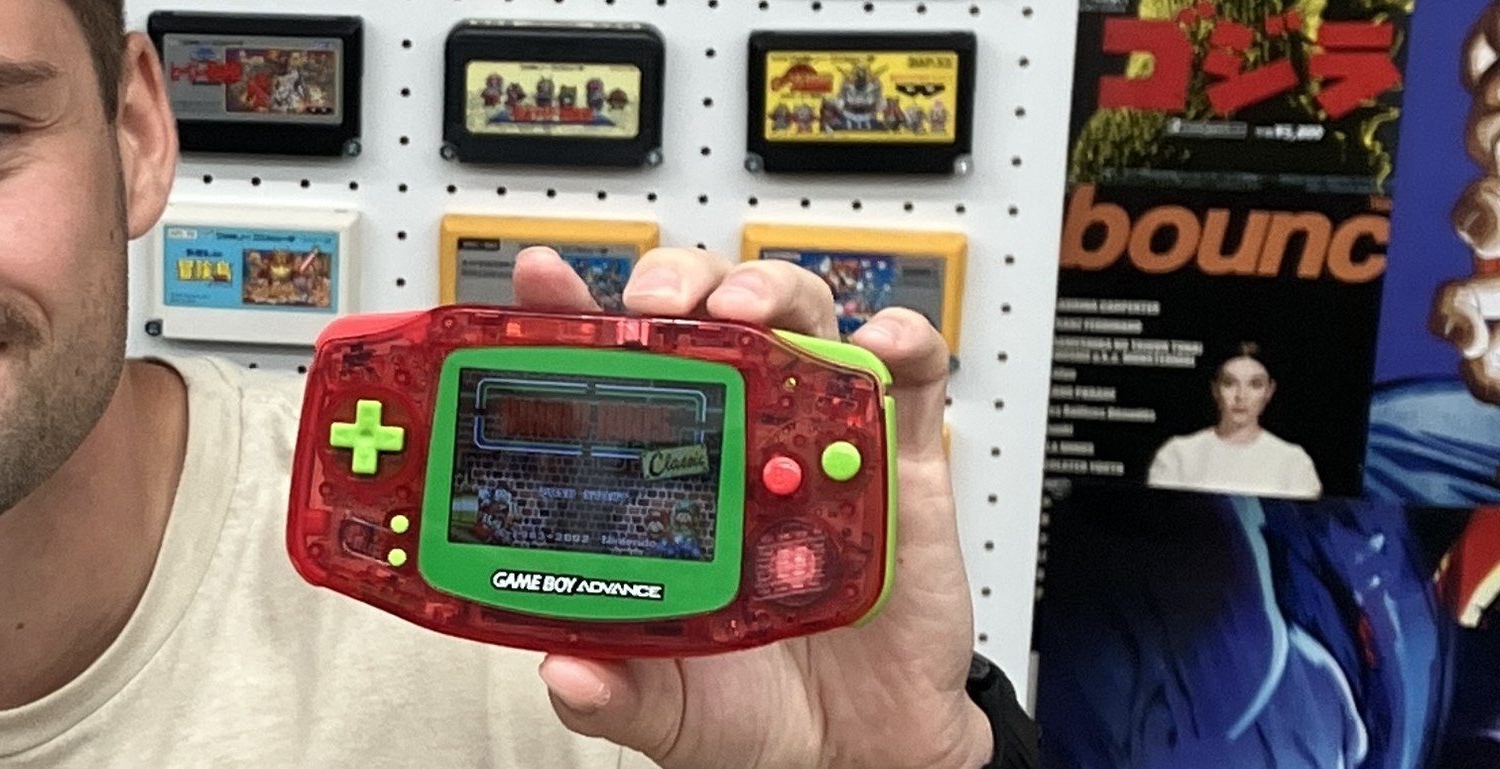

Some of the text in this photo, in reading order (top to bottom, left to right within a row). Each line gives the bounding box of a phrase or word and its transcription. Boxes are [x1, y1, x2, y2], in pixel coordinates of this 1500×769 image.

[1098, 4, 1402, 119] ゴジラ
[492, 571, 663, 599] GAME BOY ADVANCE
